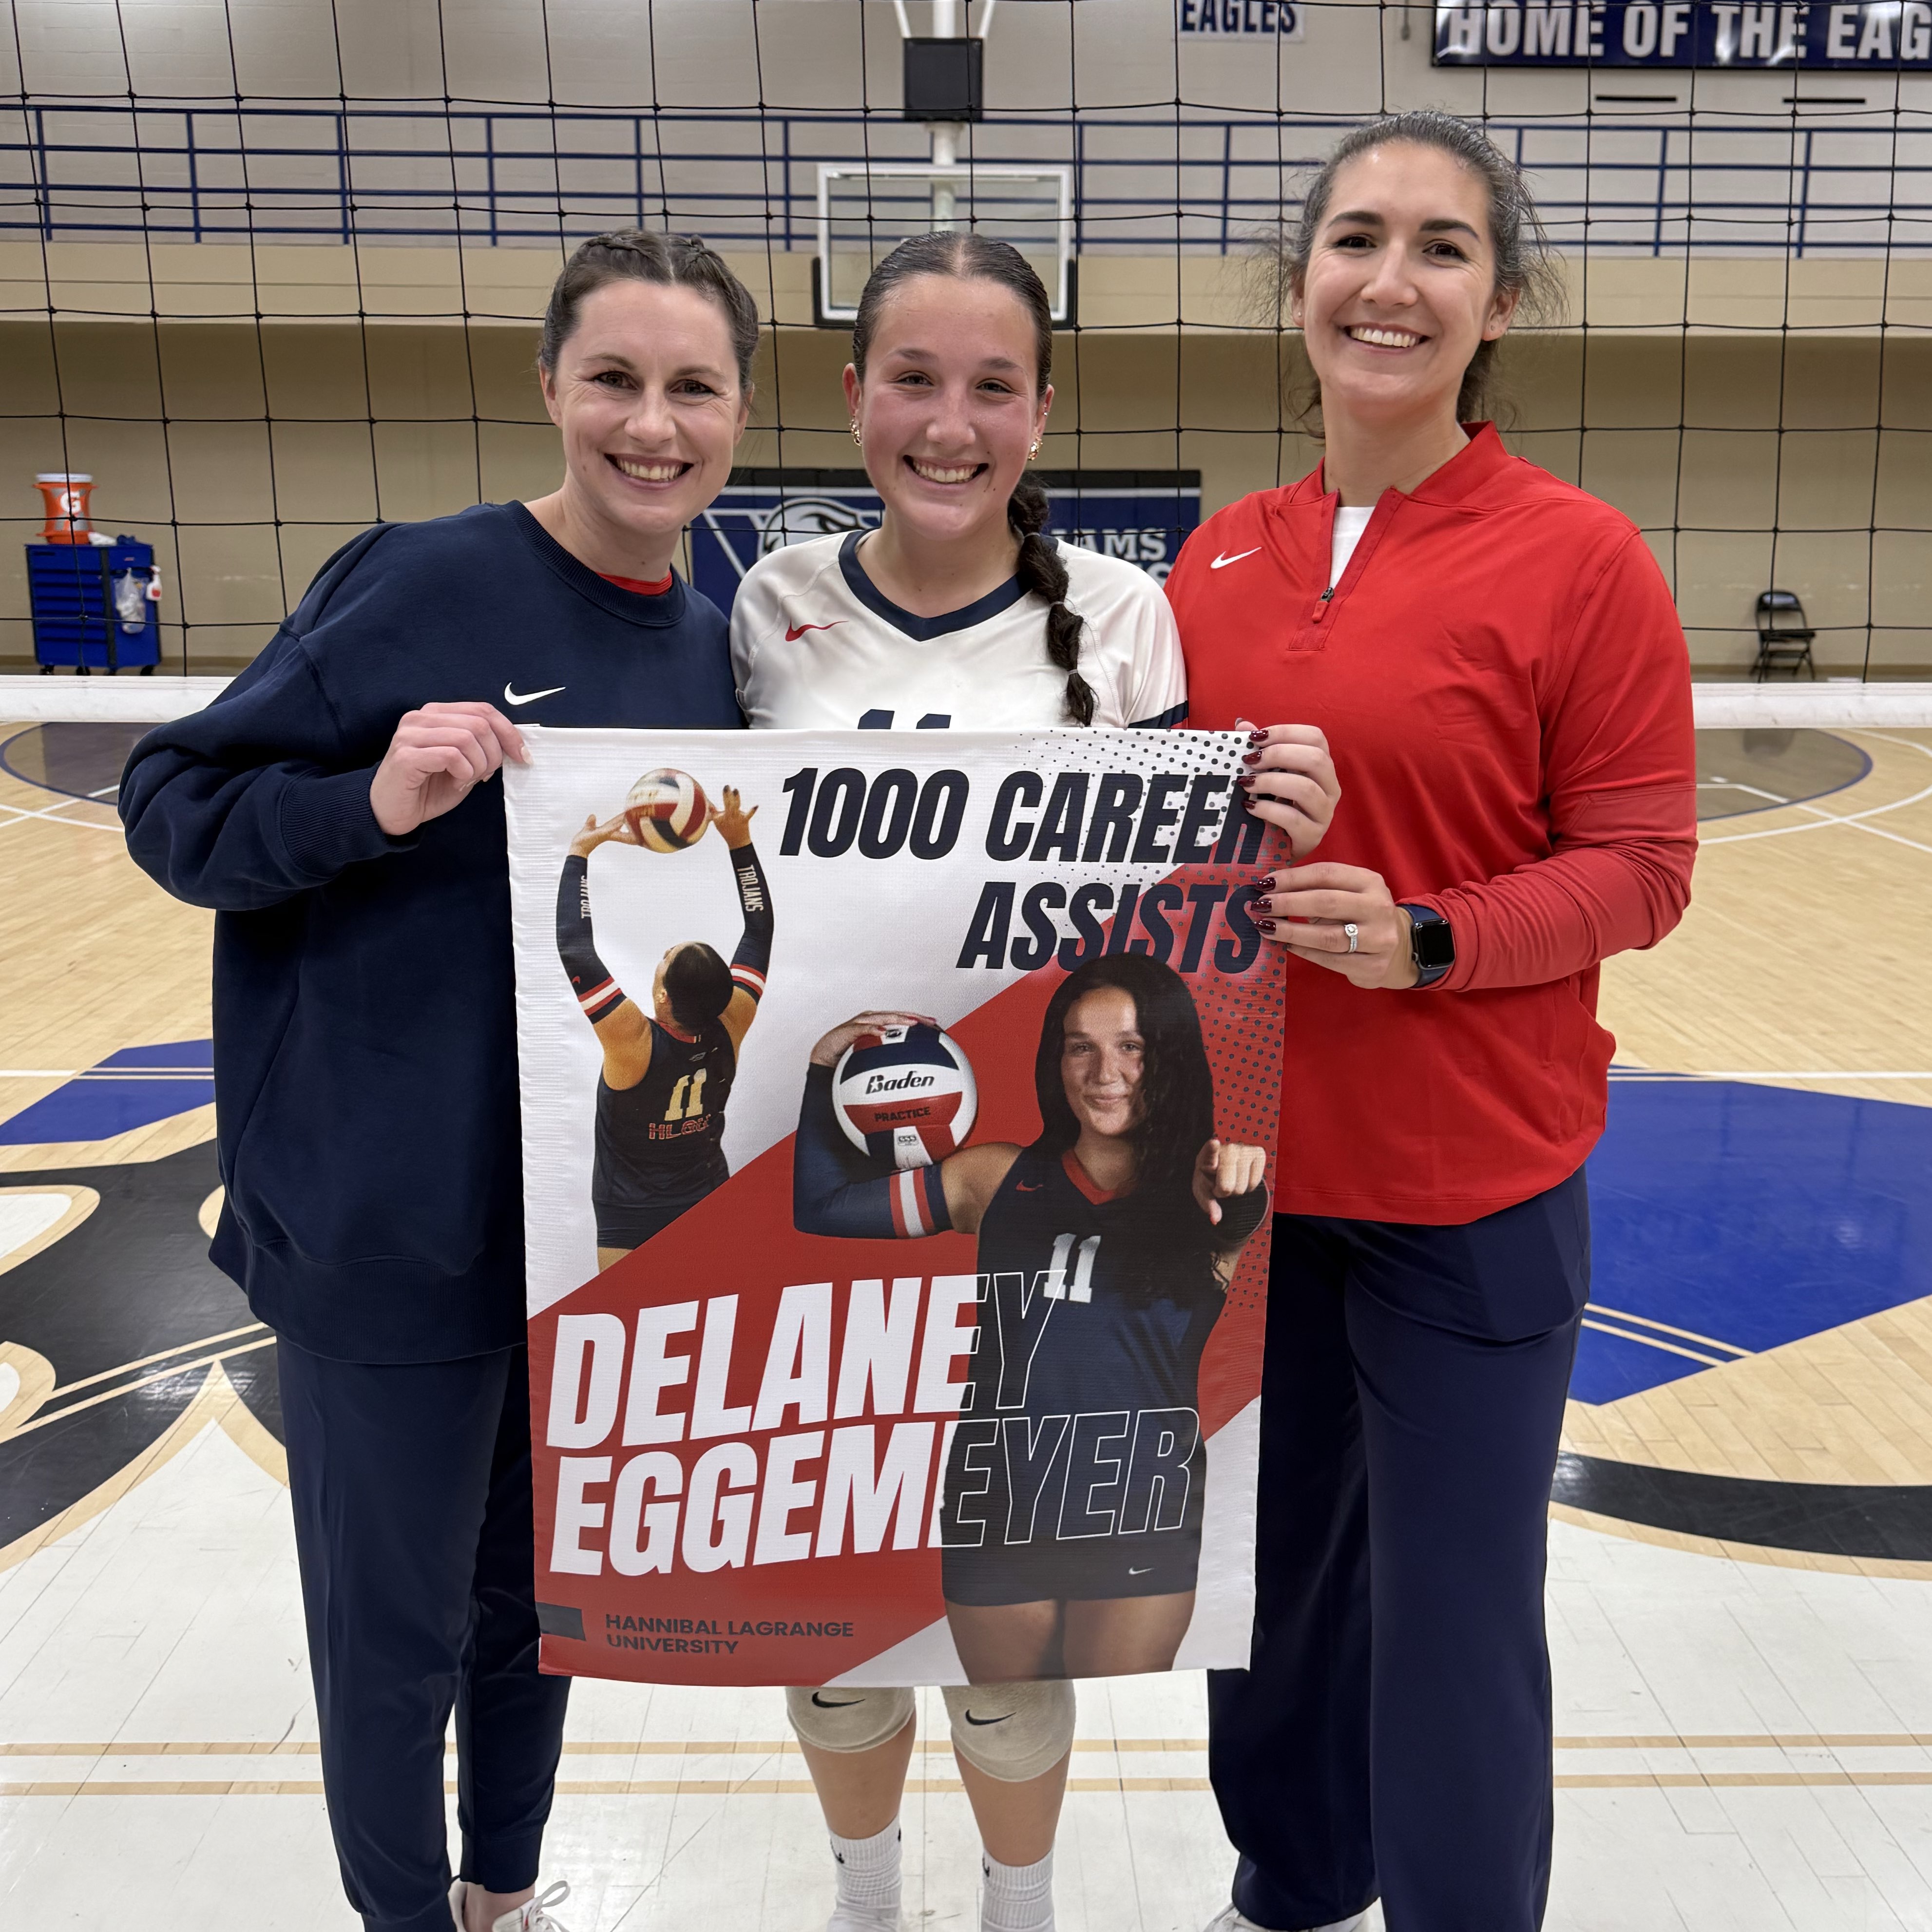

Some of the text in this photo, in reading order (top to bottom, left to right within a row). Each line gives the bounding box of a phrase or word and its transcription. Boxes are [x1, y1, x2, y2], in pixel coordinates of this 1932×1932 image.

[1181, 0, 1296, 33] EAGLES
[1448, 0, 1932, 59] HOME OF THE EAG
[780, 767, 1268, 864] 1000 CAREER
[737, 864, 764, 912] TROJANS
[956, 881, 1263, 974] ASSISTS
[664, 1068, 707, 1121] 11
[865, 1070, 935, 1094] Baden
[874, 1107, 931, 1122] PRACTICE
[1043, 1233, 1101, 1303] 11
[546, 1269, 1068, 1449] DELANEY
[550, 1407, 1200, 1576] EGGEMEYER
[605, 1614, 854, 1638] HANNIBAL LAGRANGE
[606, 1634, 739, 1654] UNIVERSITY
